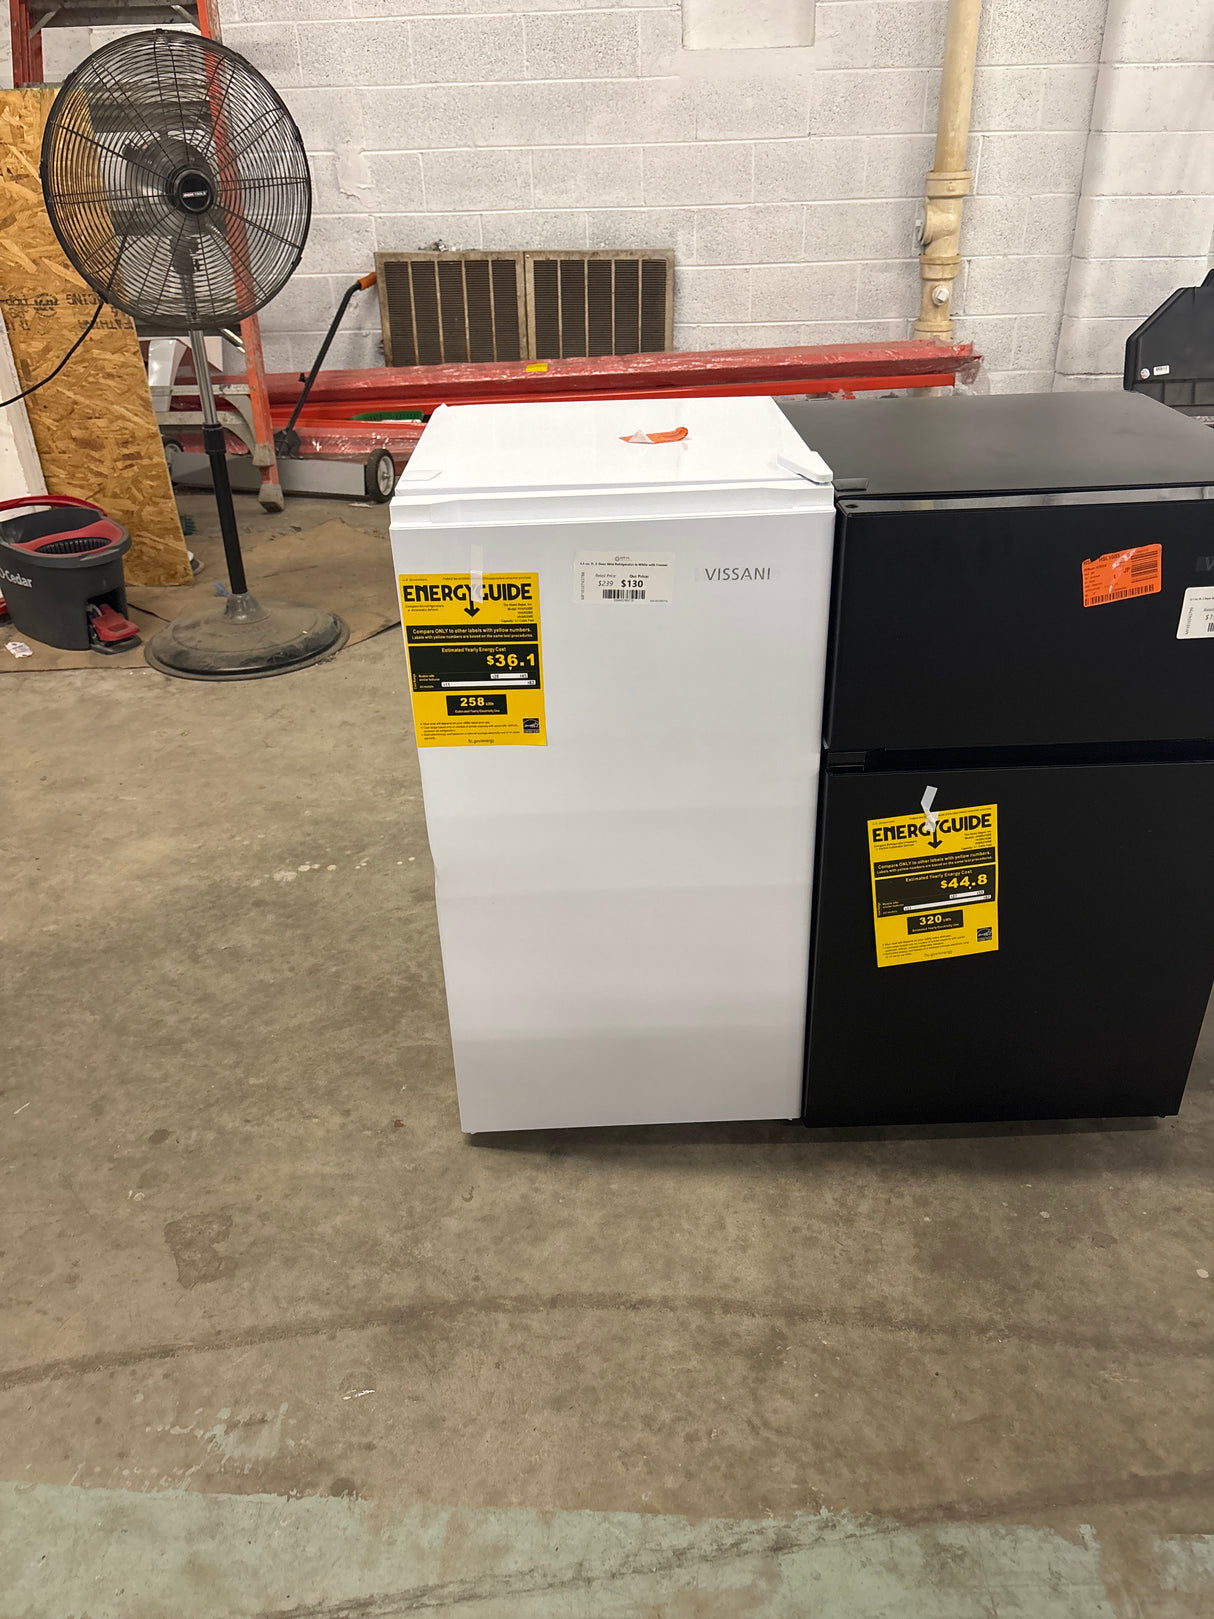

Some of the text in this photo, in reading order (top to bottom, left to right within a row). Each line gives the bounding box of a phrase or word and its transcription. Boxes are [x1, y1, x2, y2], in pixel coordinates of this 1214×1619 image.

[704, 567, 771, 581] VISSANI
[621, 579, 644, 588] $130
[486, 653, 535, 667] $36.1
[460, 697, 485, 707] 258
[905, 874, 929, 883] Estimated
[944, 870, 960, 878] Energy
[940, 873, 988, 889] $44.8
[919, 914, 942, 926] 320
